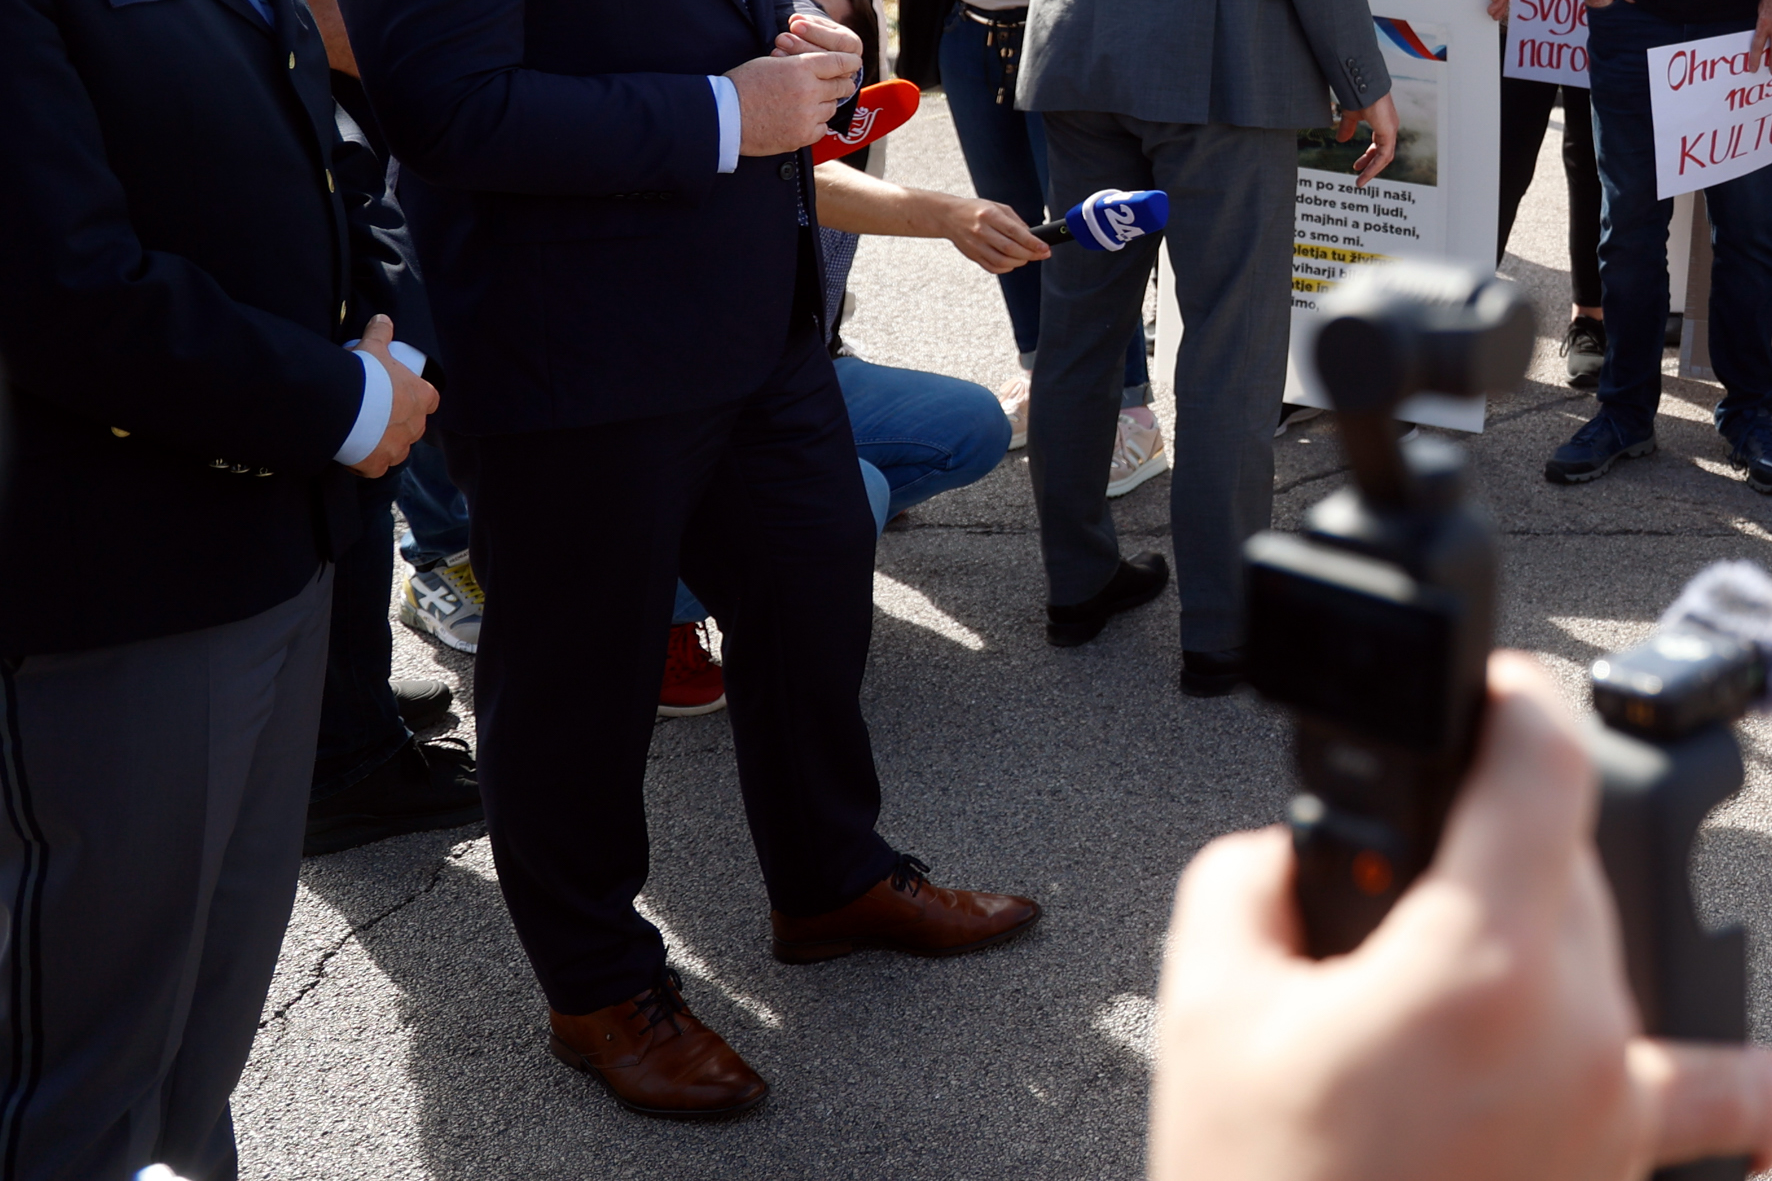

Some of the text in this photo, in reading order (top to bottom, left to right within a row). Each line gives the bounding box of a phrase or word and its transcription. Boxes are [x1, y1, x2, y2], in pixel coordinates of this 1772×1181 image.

[1518, 38, 1589, 72] naro
[1316, 180, 1334, 192] po
[1338, 182, 1380, 199] zemlji
[1383, 189, 1416, 205] naši,
[1295, 193, 1407, 220] dobre sem ljudi,
[1301, 213, 1420, 239] majhni a pošteni,
[1310, 231, 1339, 244] smo
[1343, 236, 1364, 248] mi.
[1331, 250, 1346, 262] tu
